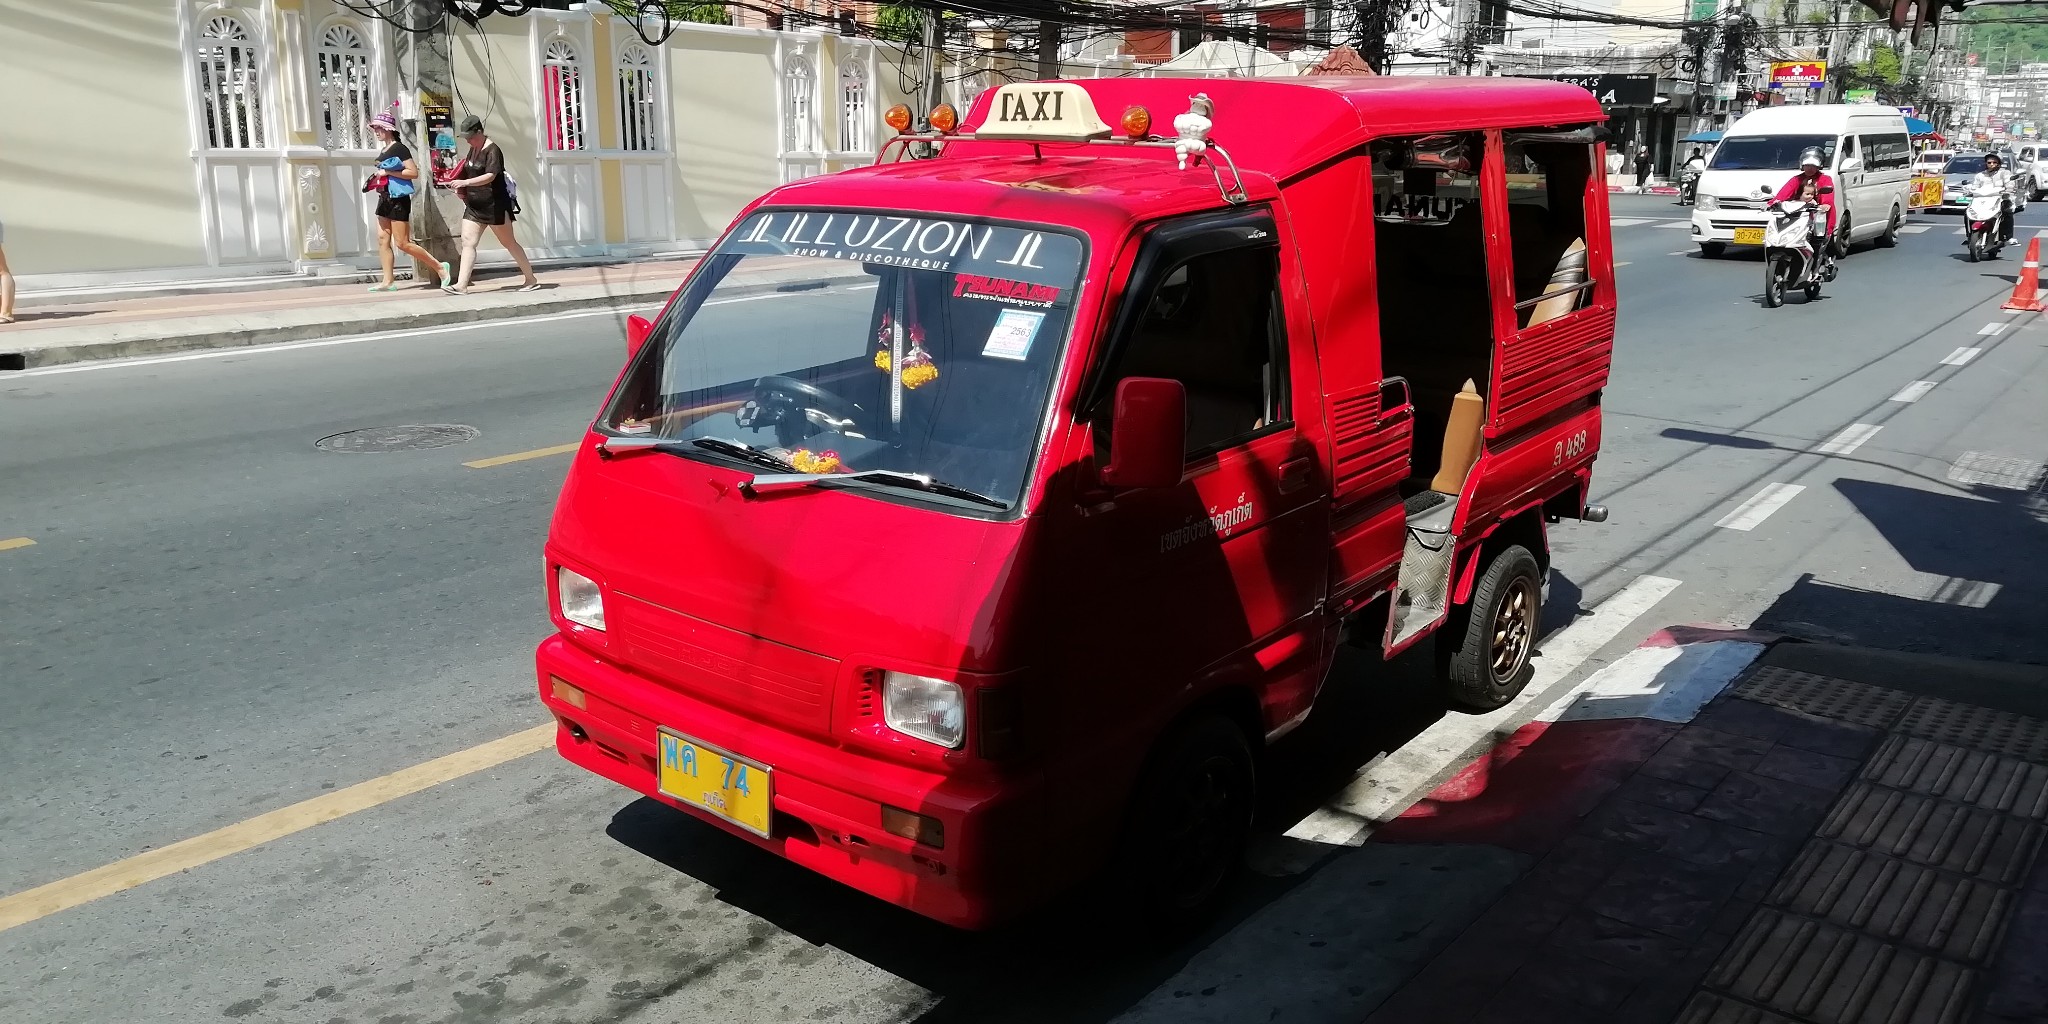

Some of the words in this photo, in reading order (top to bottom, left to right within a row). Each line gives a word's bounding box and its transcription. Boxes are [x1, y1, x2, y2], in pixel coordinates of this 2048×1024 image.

[999, 91, 1063, 122] TAXI
[780, 213, 993, 260] ILLUZION
[793, 247, 829, 259] SHOW
[834, 250, 842, 259] &
[849, 251, 951, 271] DISCOTHEQUE
[953, 273, 1060, 304] TSUNAMI
[1010, 326, 1032, 338] 2563
[1566, 429, 1587, 460] 488
[1160, 492, 1252, 553] เขตจังหวัดภูเก็ต
[720, 756, 751, 798] 74
